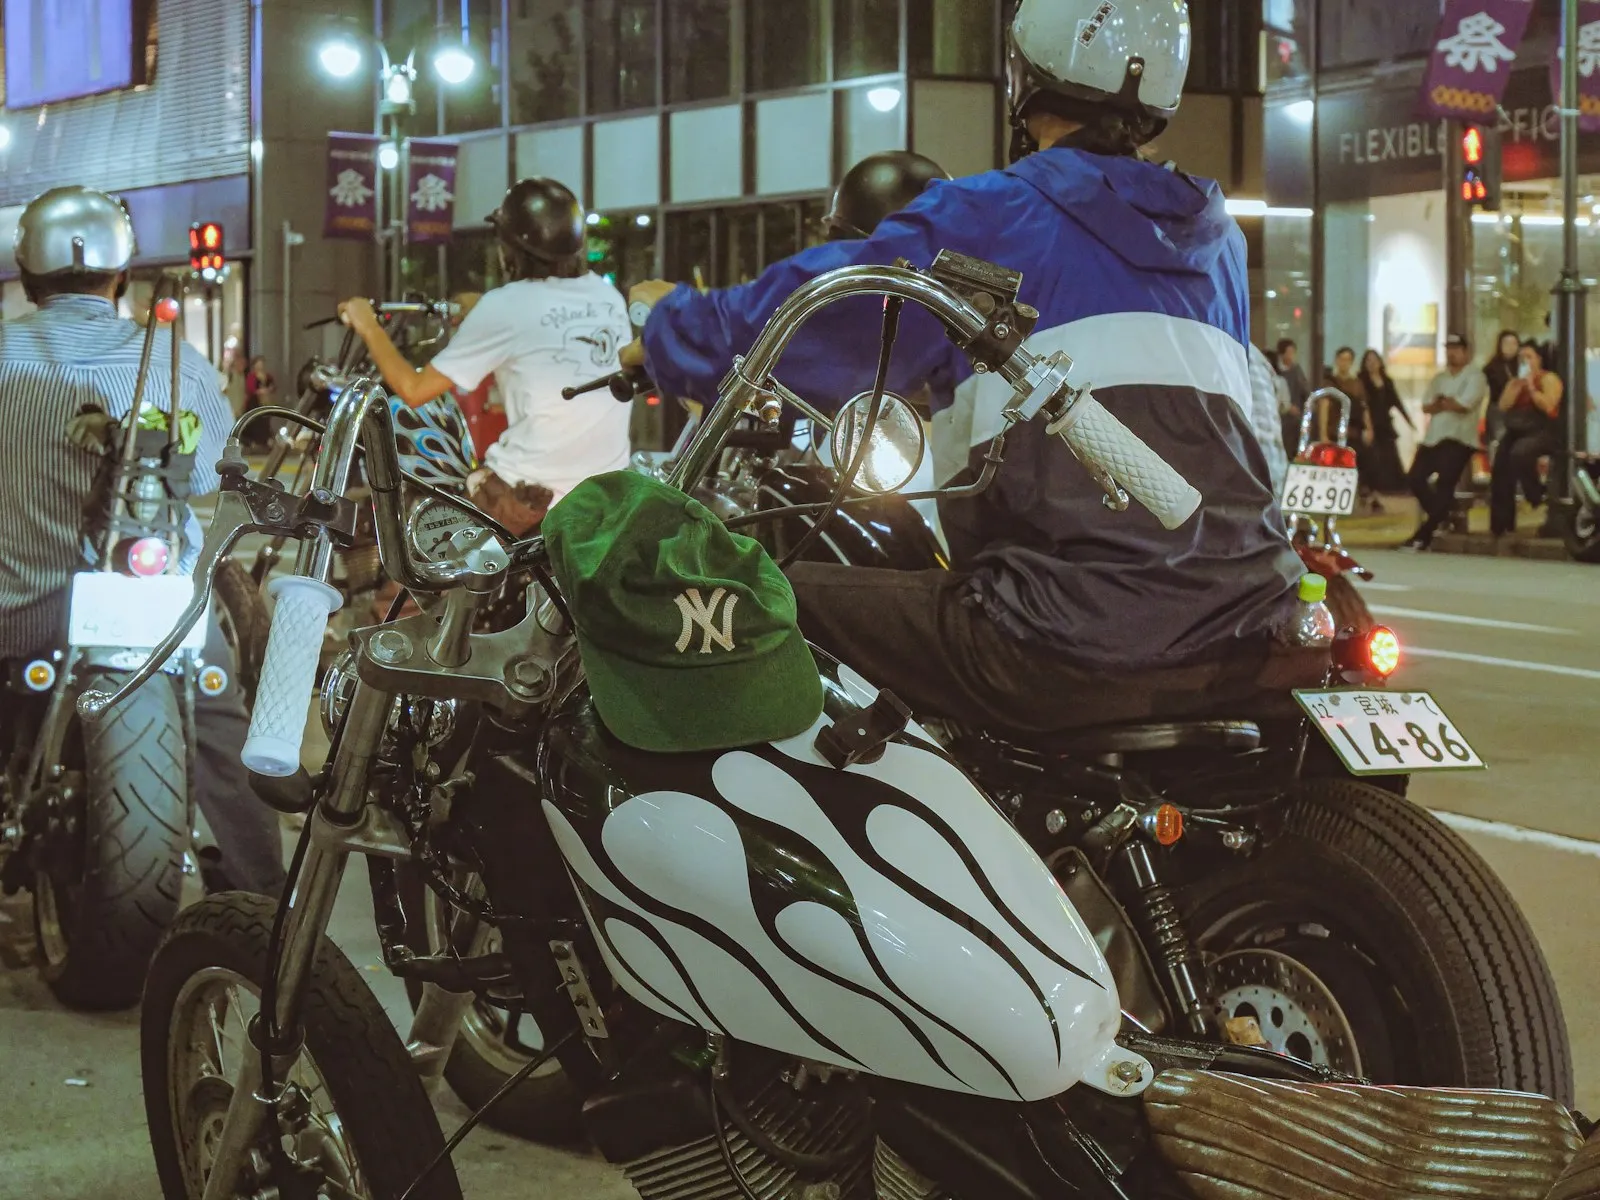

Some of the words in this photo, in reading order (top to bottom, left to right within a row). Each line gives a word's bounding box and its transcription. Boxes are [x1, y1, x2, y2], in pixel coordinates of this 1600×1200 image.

[1436, 11, 1516, 72] 祭
[673, 588, 739, 653] NY
[1353, 695, 1399, 716] 宮城
[1336, 722, 1470, 765] 14-86
